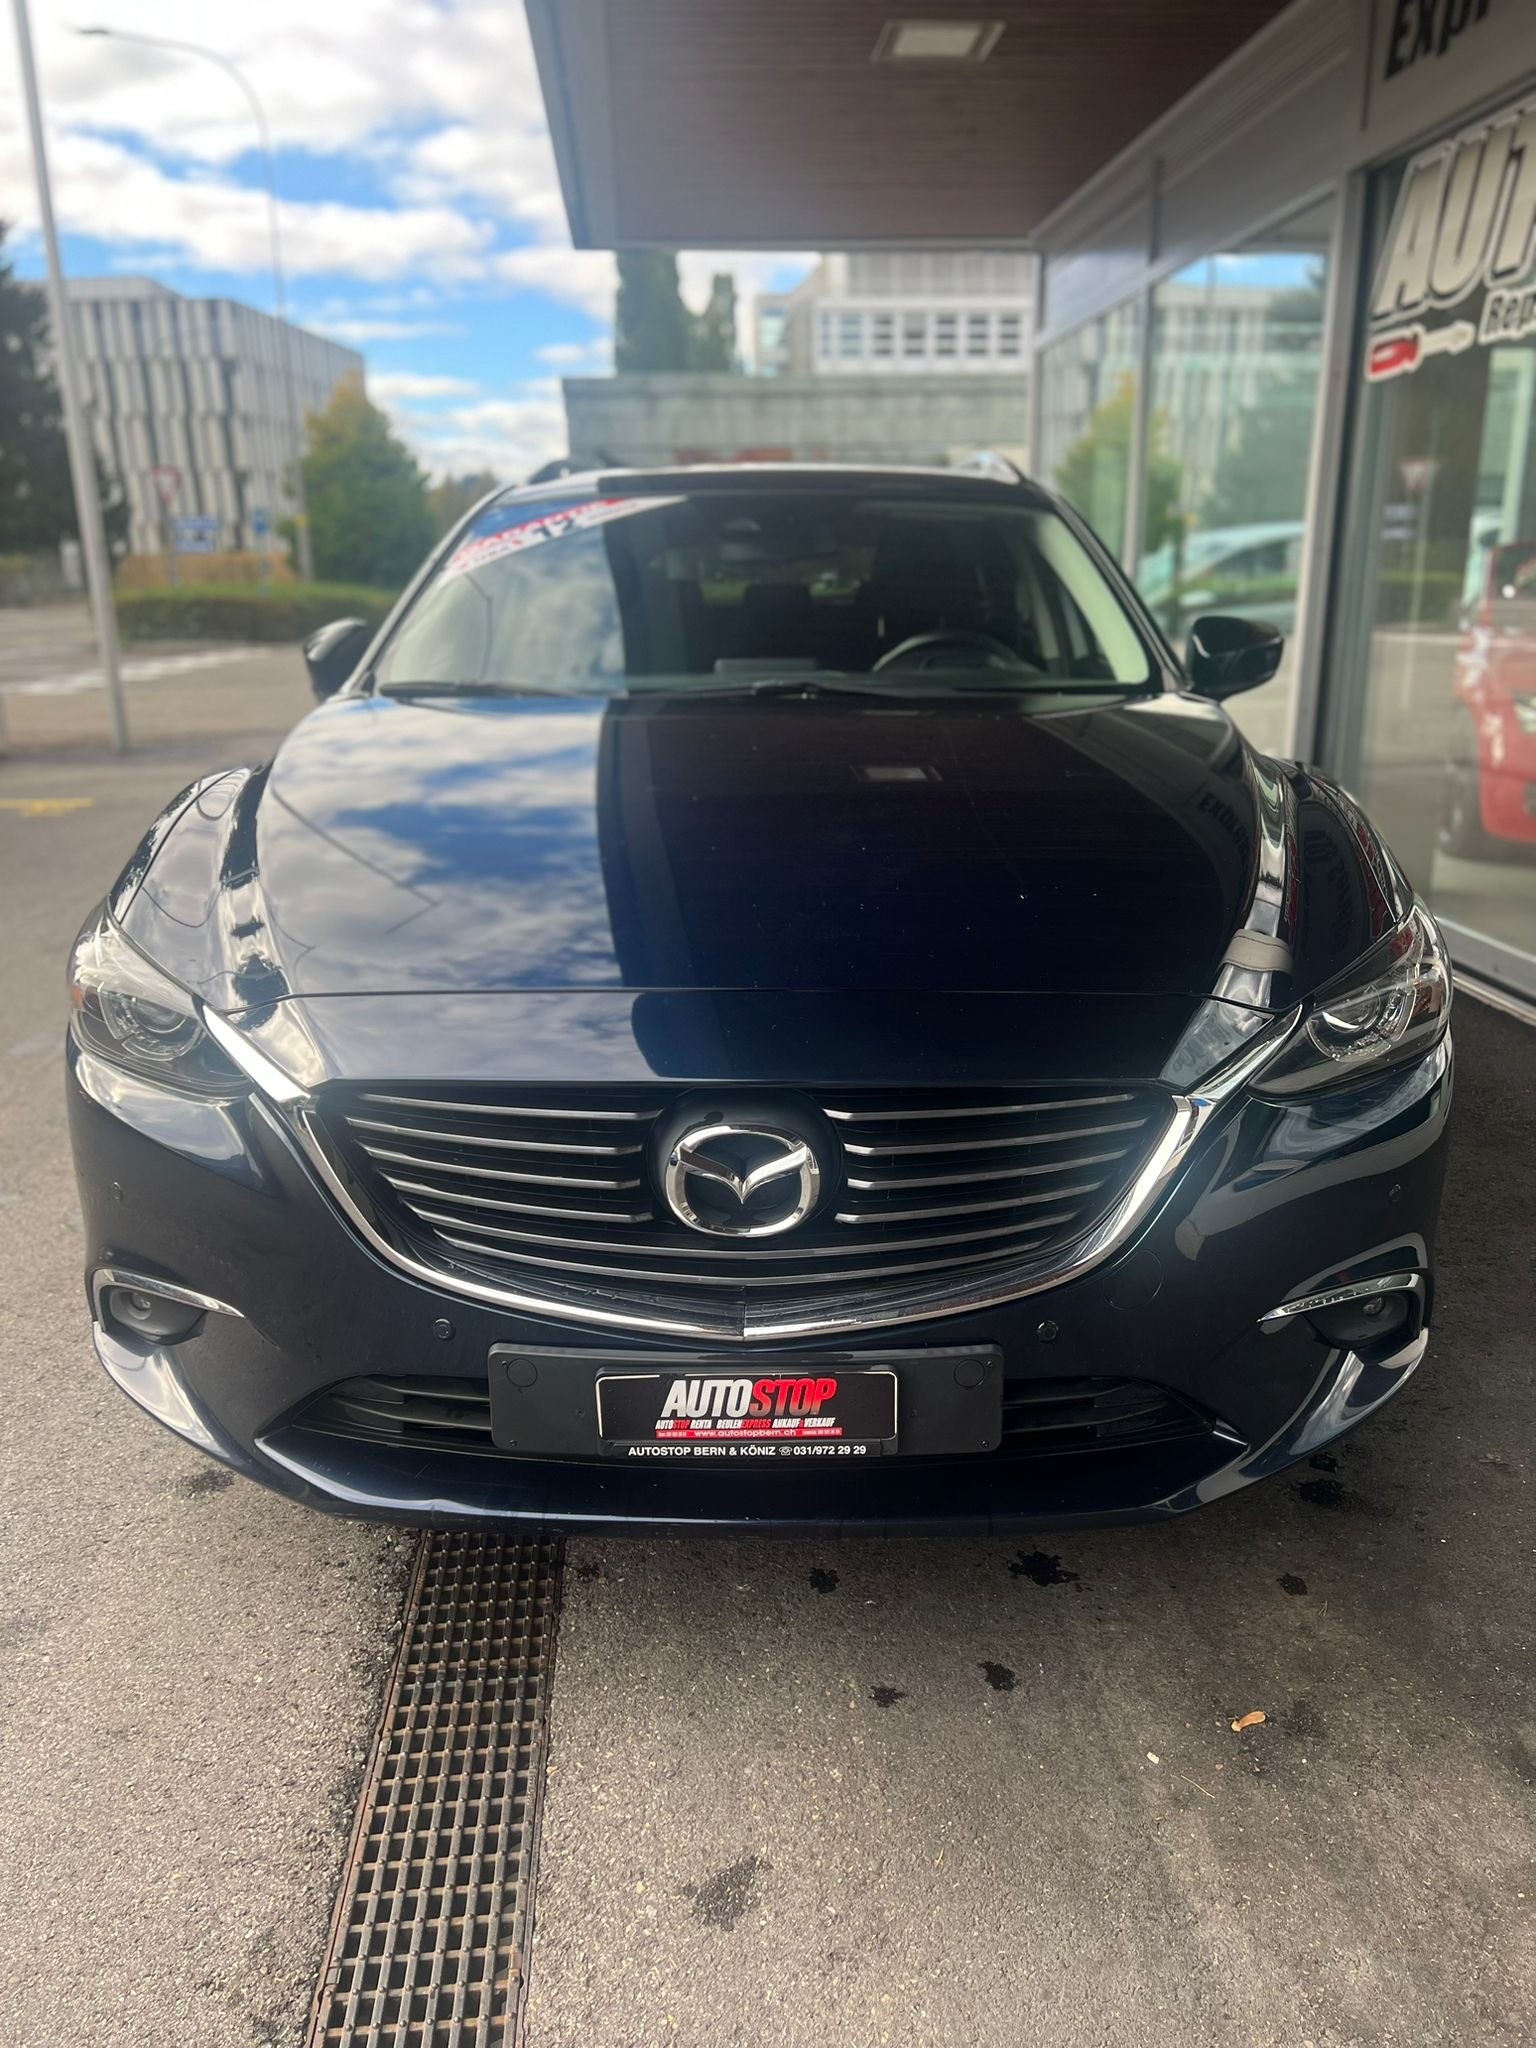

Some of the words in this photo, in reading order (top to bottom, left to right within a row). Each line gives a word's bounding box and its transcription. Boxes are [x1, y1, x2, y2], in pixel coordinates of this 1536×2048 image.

[661, 1378, 838, 1418] AUTOSTOP
[690, 1418, 712, 1430] RENTA
[693, 1428, 797, 1438] www.autostopbern.ch
[628, 1446, 691, 1456] AUTOSTOP
[693, 1446, 726, 1456] BERN
[729, 1446, 738, 1456] &
[740, 1444, 776, 1456] KÖNIZ
[793, 1446, 835, 1456] 031/972
[837, 1445, 851, 1455] 29
[853, 1445, 867, 1455] 29
